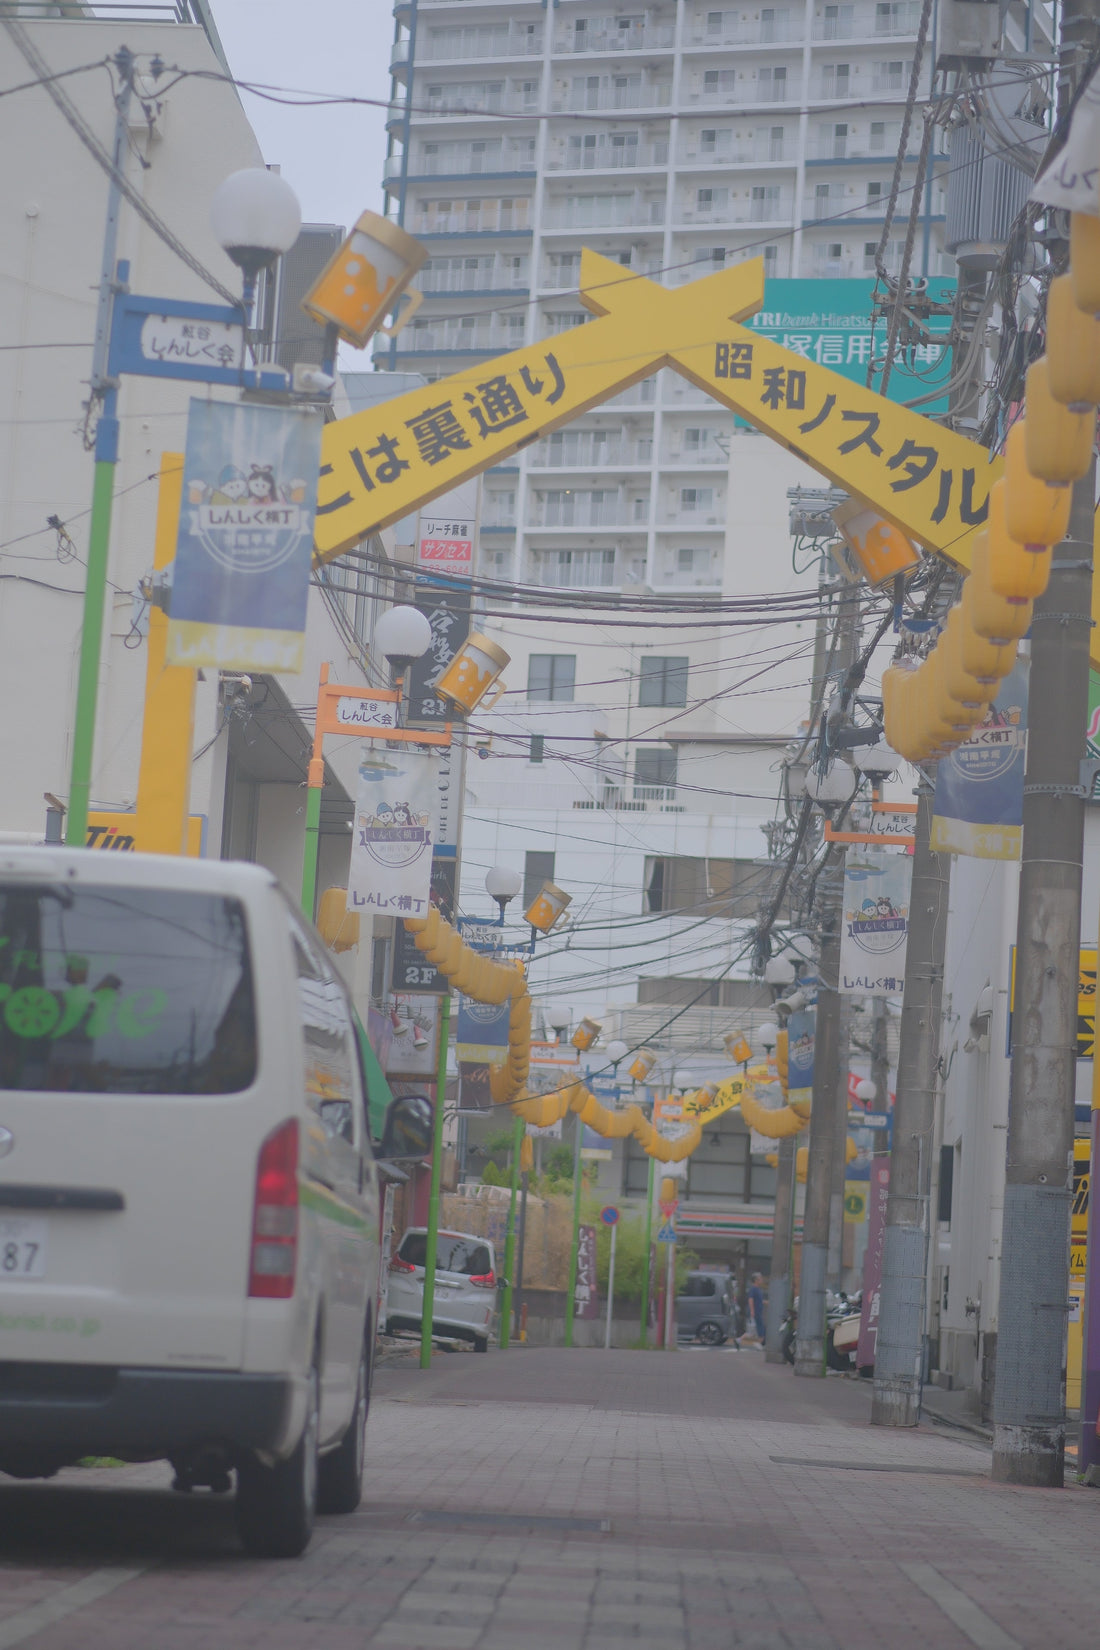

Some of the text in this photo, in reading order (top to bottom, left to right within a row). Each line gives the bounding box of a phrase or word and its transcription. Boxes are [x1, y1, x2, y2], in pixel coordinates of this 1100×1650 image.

[151, 336, 234, 368] しんしく会
[208, 508, 295, 526] しんしく横丁
[427, 522, 468, 537] リーチ麻雀
[424, 541, 469, 559] サクセス
[341, 709, 393, 726] しんしく会
[352, 890, 426, 913] しんしく横丁
[405, 966, 438, 985] 2F
